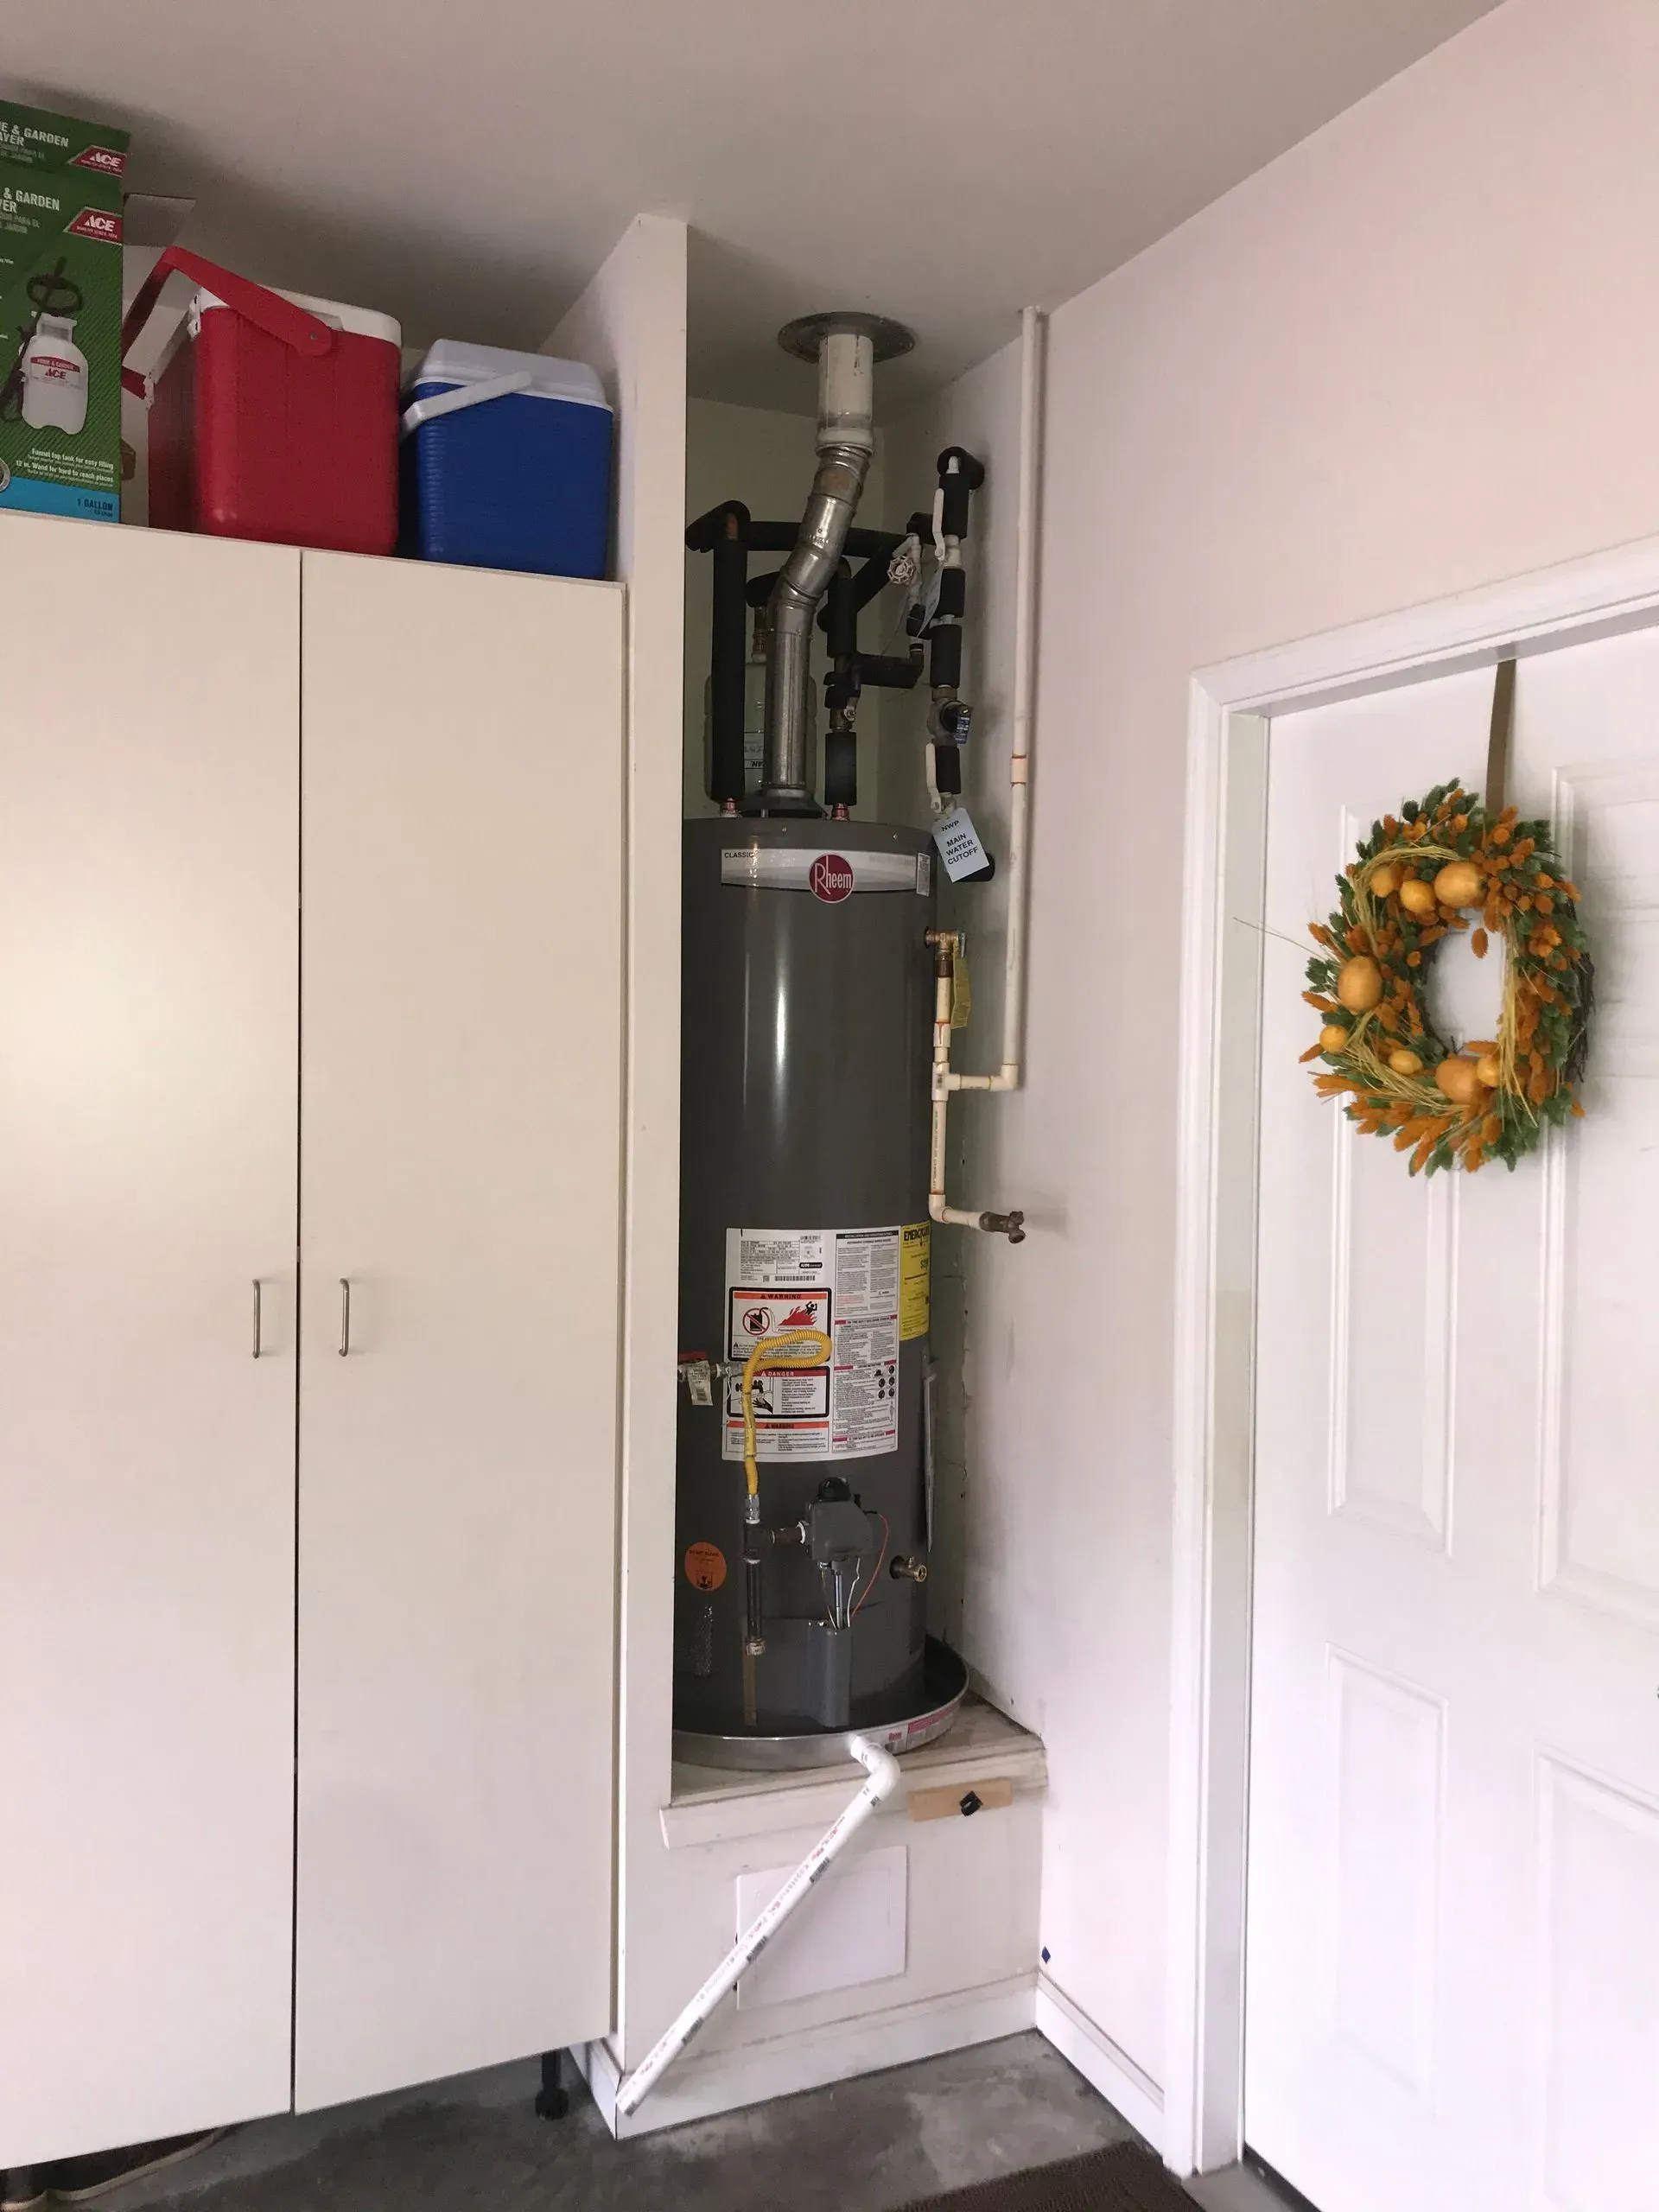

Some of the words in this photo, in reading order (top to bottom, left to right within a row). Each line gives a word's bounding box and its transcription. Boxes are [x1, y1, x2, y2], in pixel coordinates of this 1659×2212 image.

[11, 124, 21, 136] &
[24, 127, 69, 147] GARDEN
[89, 152, 122, 167] ACE
[3, 188, 12, 200] &
[16, 189, 60, 211] GARDEN
[84, 215, 116, 232] ACE
[44, 368, 67, 379] ACE
[32, 448, 50, 458] Funnel
[51, 452, 61, 461] top
[61, 453, 75, 461] tank
[31, 462, 48, 471] Wand
[96, 474, 114, 483] places
[77, 498, 82, 506] 1
[84, 499, 113, 512] GALLON
[941, 820, 959, 831] NWP
[945, 839, 974, 855] WATER
[946, 833, 967, 847] MAIN
[947, 846, 978, 865] CUTOFF
[815, 855, 852, 895] Rheem
